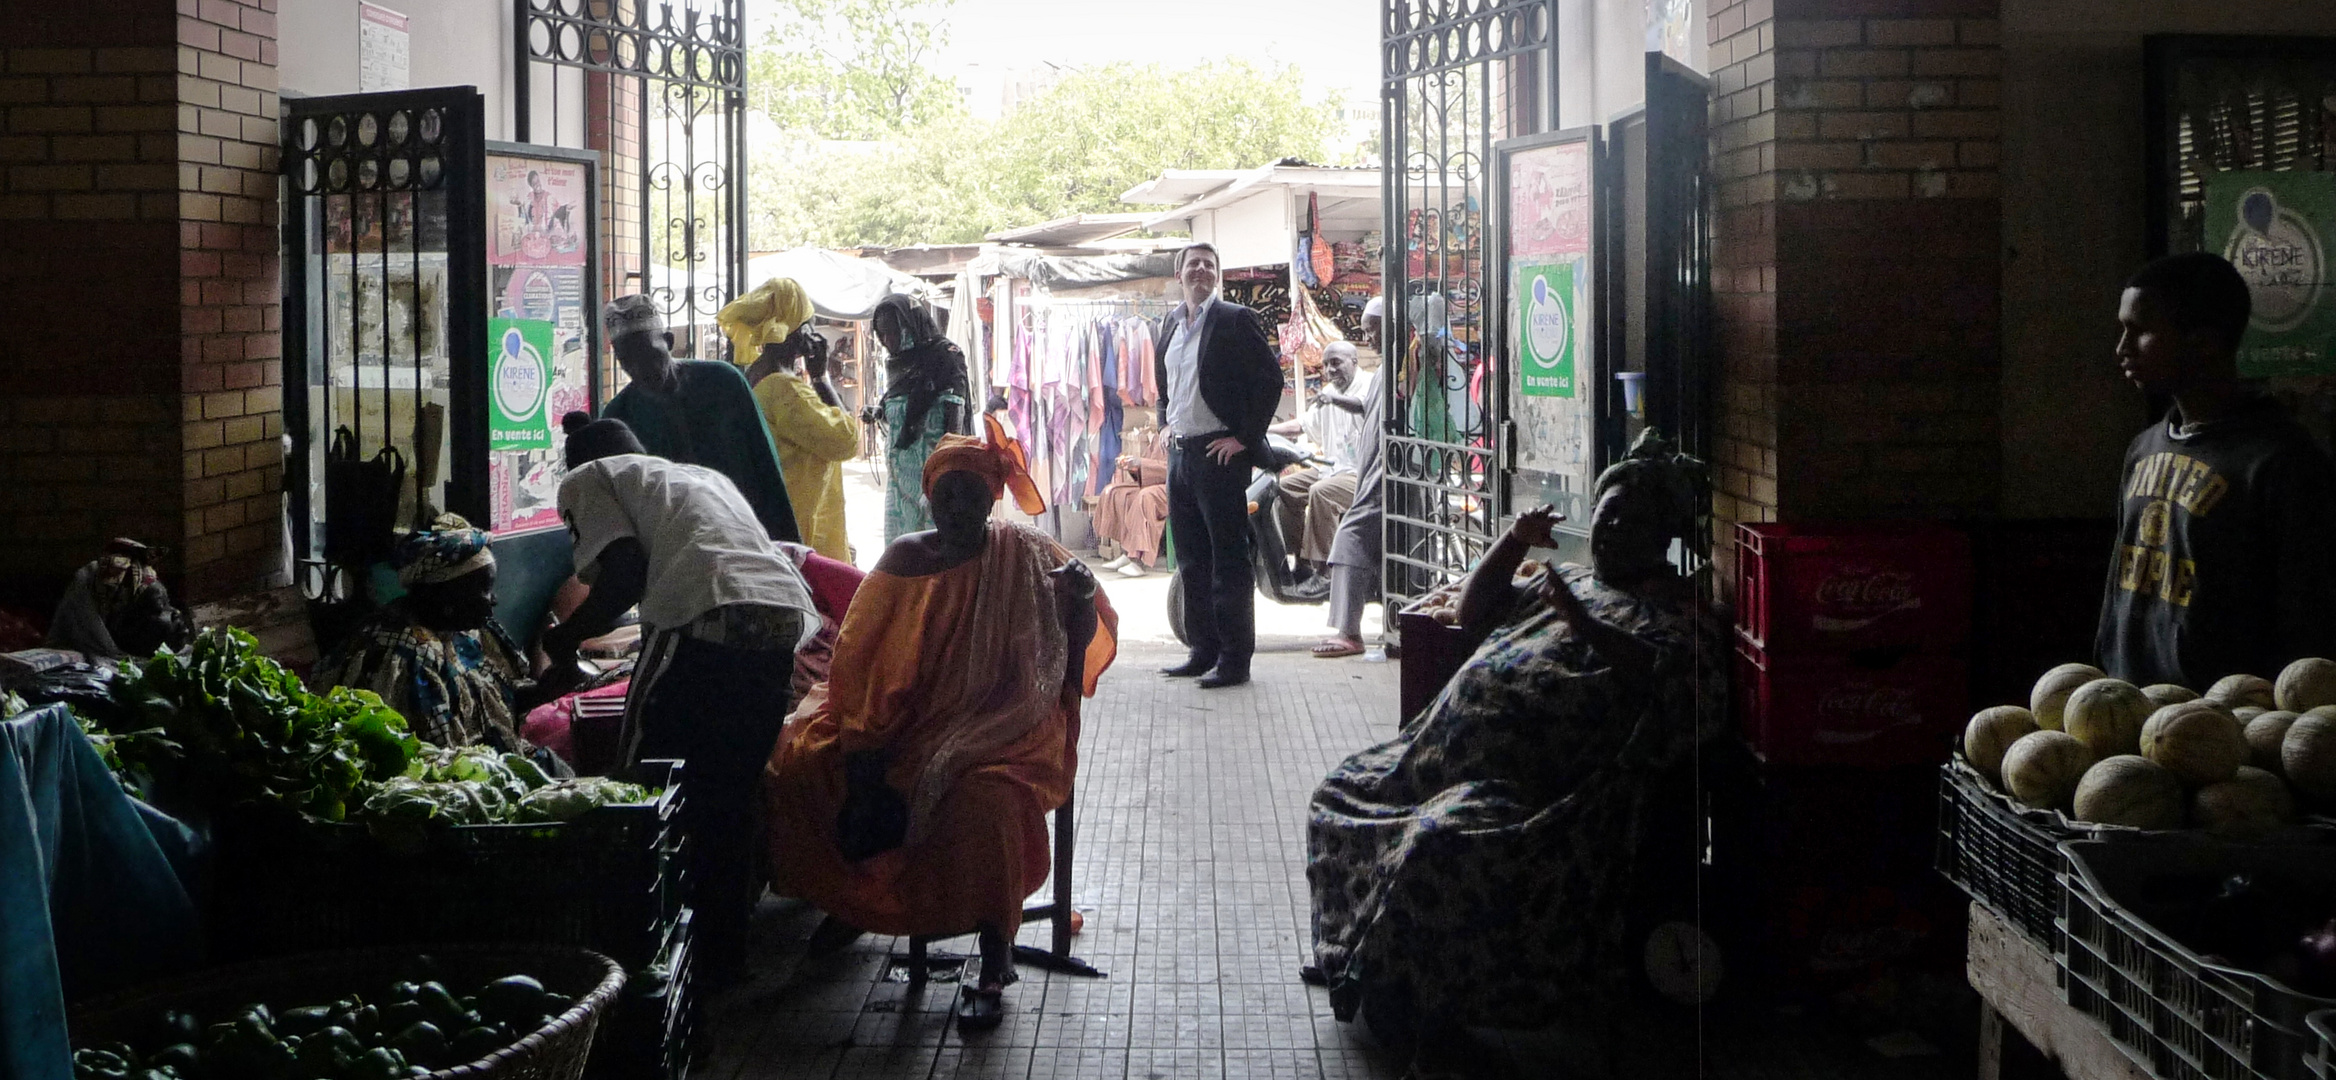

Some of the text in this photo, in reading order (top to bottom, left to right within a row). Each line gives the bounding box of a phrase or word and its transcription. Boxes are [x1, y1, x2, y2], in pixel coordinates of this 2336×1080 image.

[1526, 375, 1569, 388] En vente ici
[491, 429, 545, 441] En vente ici
[2126, 452, 2228, 517] UNITED
[1815, 571, 1915, 605] Coca-Cola
